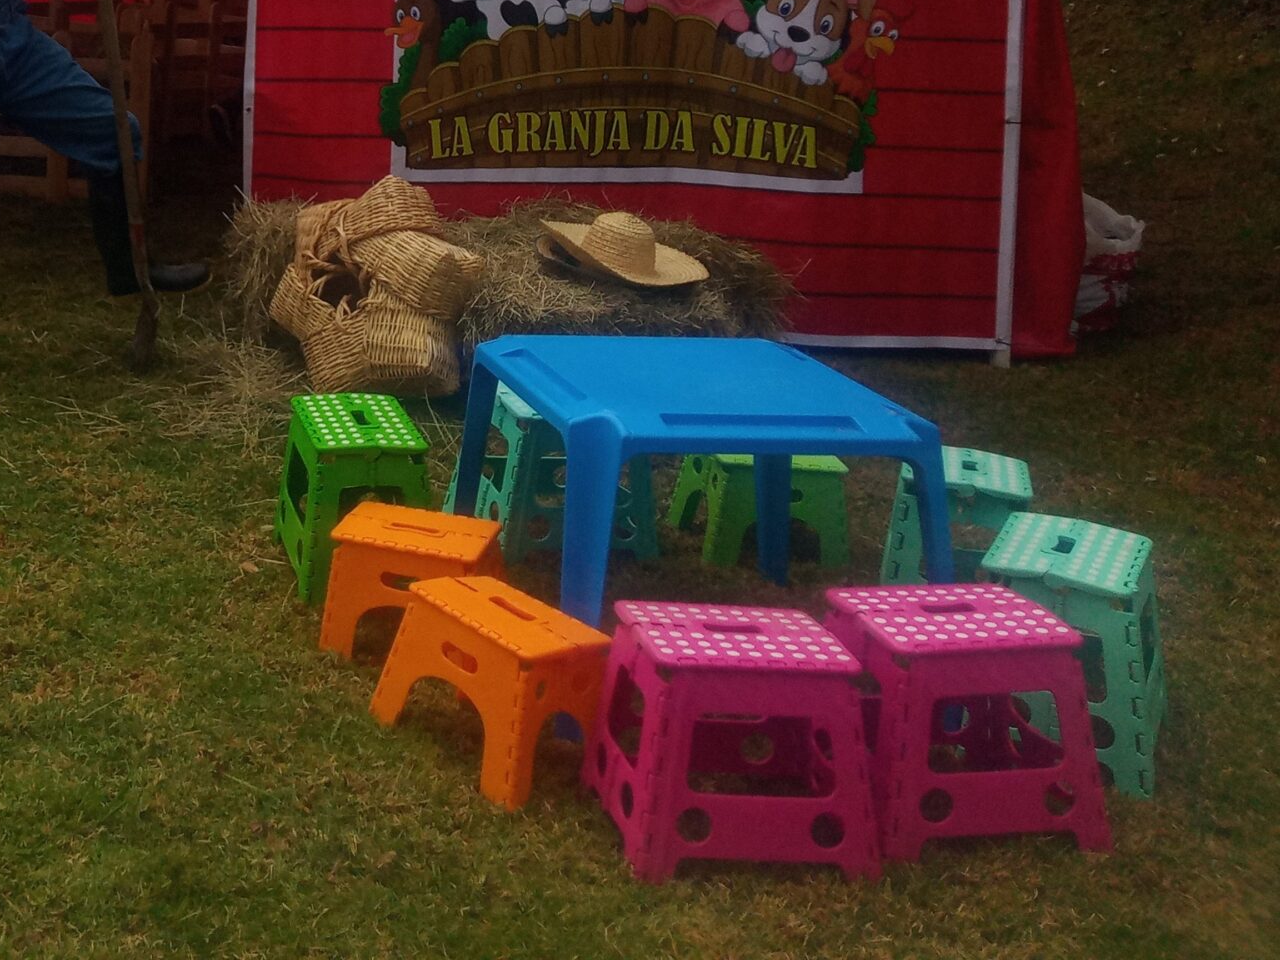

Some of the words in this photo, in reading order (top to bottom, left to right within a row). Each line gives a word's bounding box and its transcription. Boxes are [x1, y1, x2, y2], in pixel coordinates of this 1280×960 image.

[428, 115, 476, 159] LA
[487, 109, 631, 156] GRANJA
[642, 110, 697, 153] DA
[710, 114, 819, 169] SILVA
